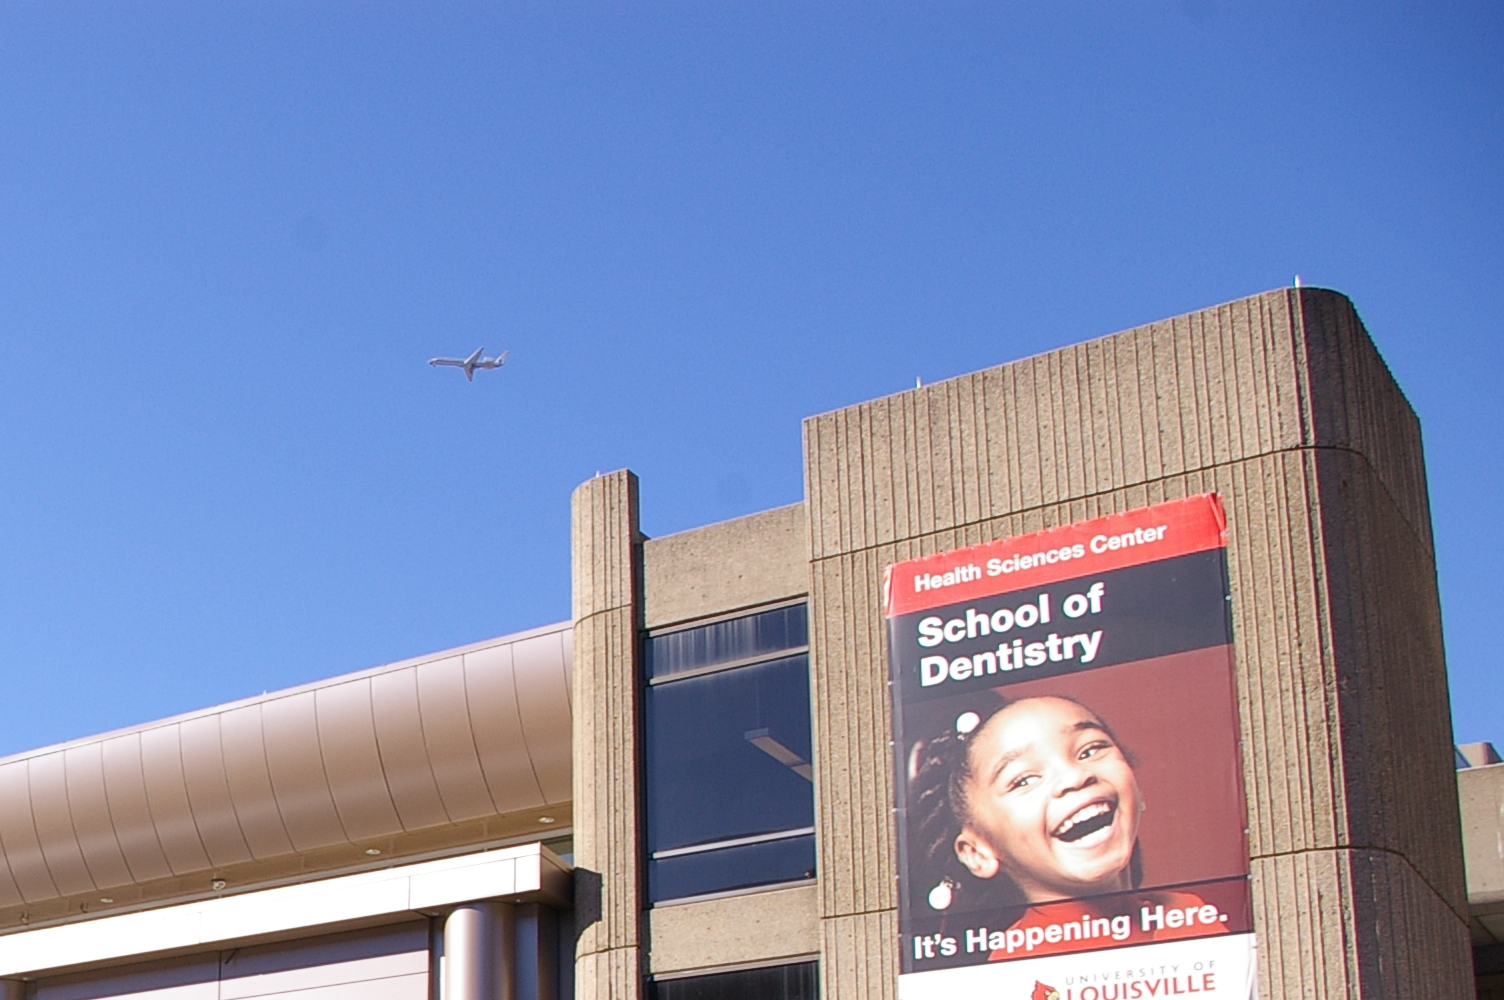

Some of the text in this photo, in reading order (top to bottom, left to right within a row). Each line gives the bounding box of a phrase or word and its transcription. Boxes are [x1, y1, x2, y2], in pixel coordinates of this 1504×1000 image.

[914, 524, 1168, 593] Health Sciences Center
[917, 582, 1105, 649] School of
[919, 628, 1104, 687] Dentistry
[913, 901, 1229, 960] It's Happening Here.
[1065, 960, 1217, 987] UNIVERSITY OF
